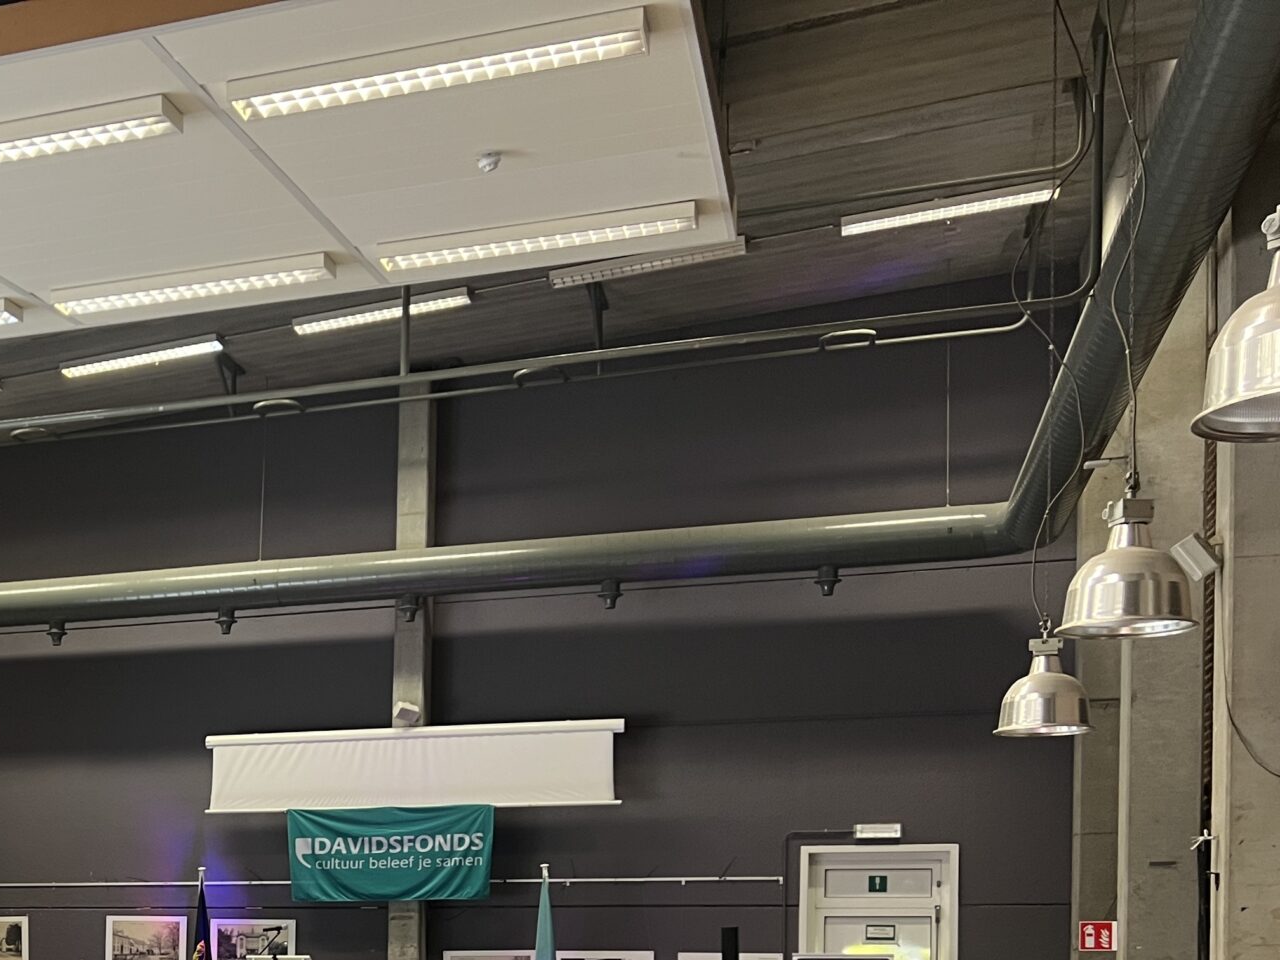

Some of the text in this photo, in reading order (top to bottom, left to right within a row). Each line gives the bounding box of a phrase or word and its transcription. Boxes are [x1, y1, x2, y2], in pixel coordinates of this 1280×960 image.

[314, 832, 484, 855] DAVIDSFONDS
[315, 855, 483, 871] cultuur beleef je samen
